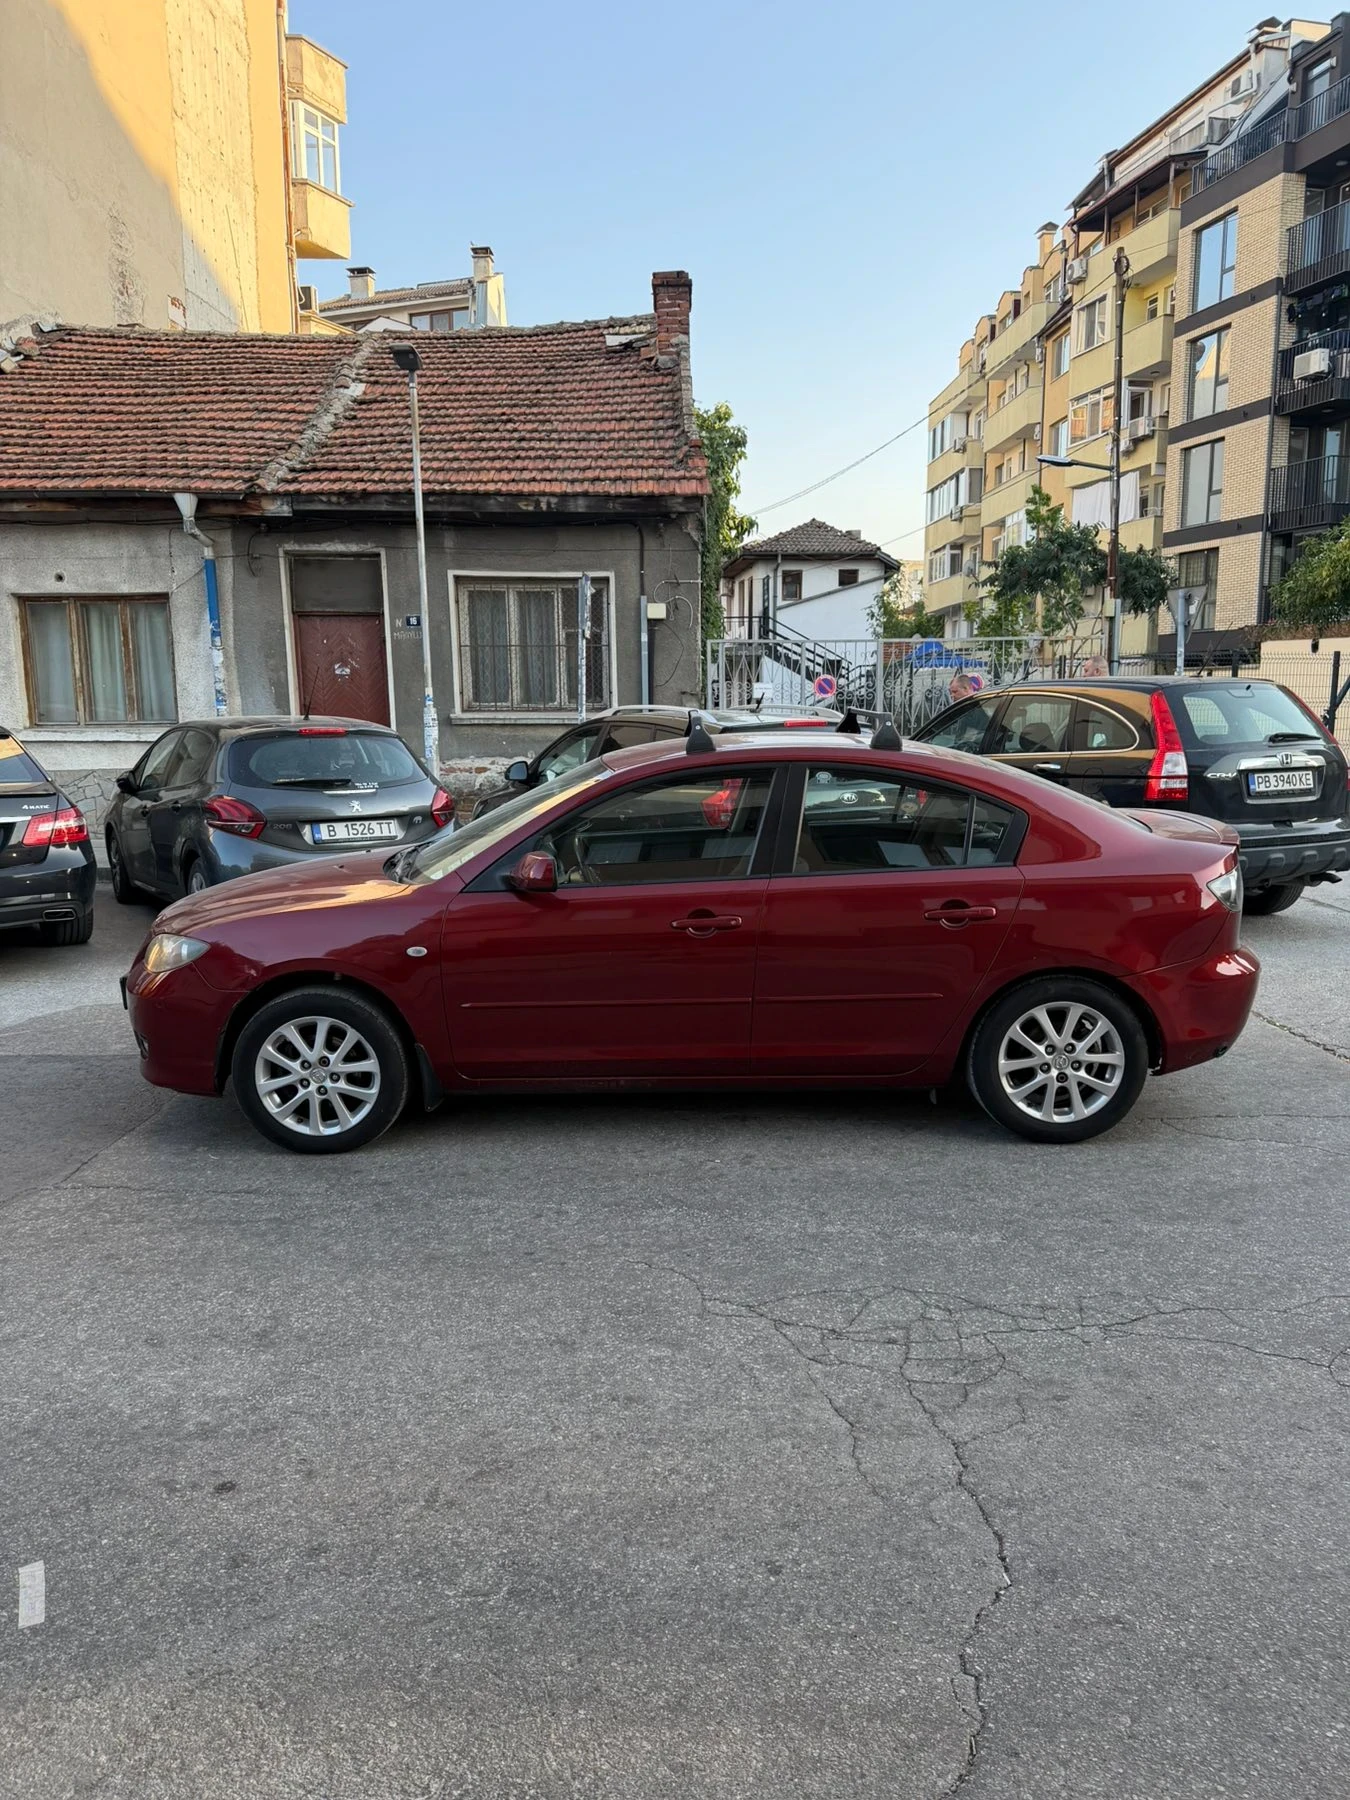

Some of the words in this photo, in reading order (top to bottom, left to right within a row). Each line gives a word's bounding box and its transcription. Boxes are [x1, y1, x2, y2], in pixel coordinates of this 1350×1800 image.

[1256, 776, 1272, 789] PB
[1273, 774, 1298, 788] 3940
[1299, 773, 1312, 786] KE
[327, 825, 337, 837] B
[344, 823, 375, 836] 1526
[376, 822, 393, 835] TT
